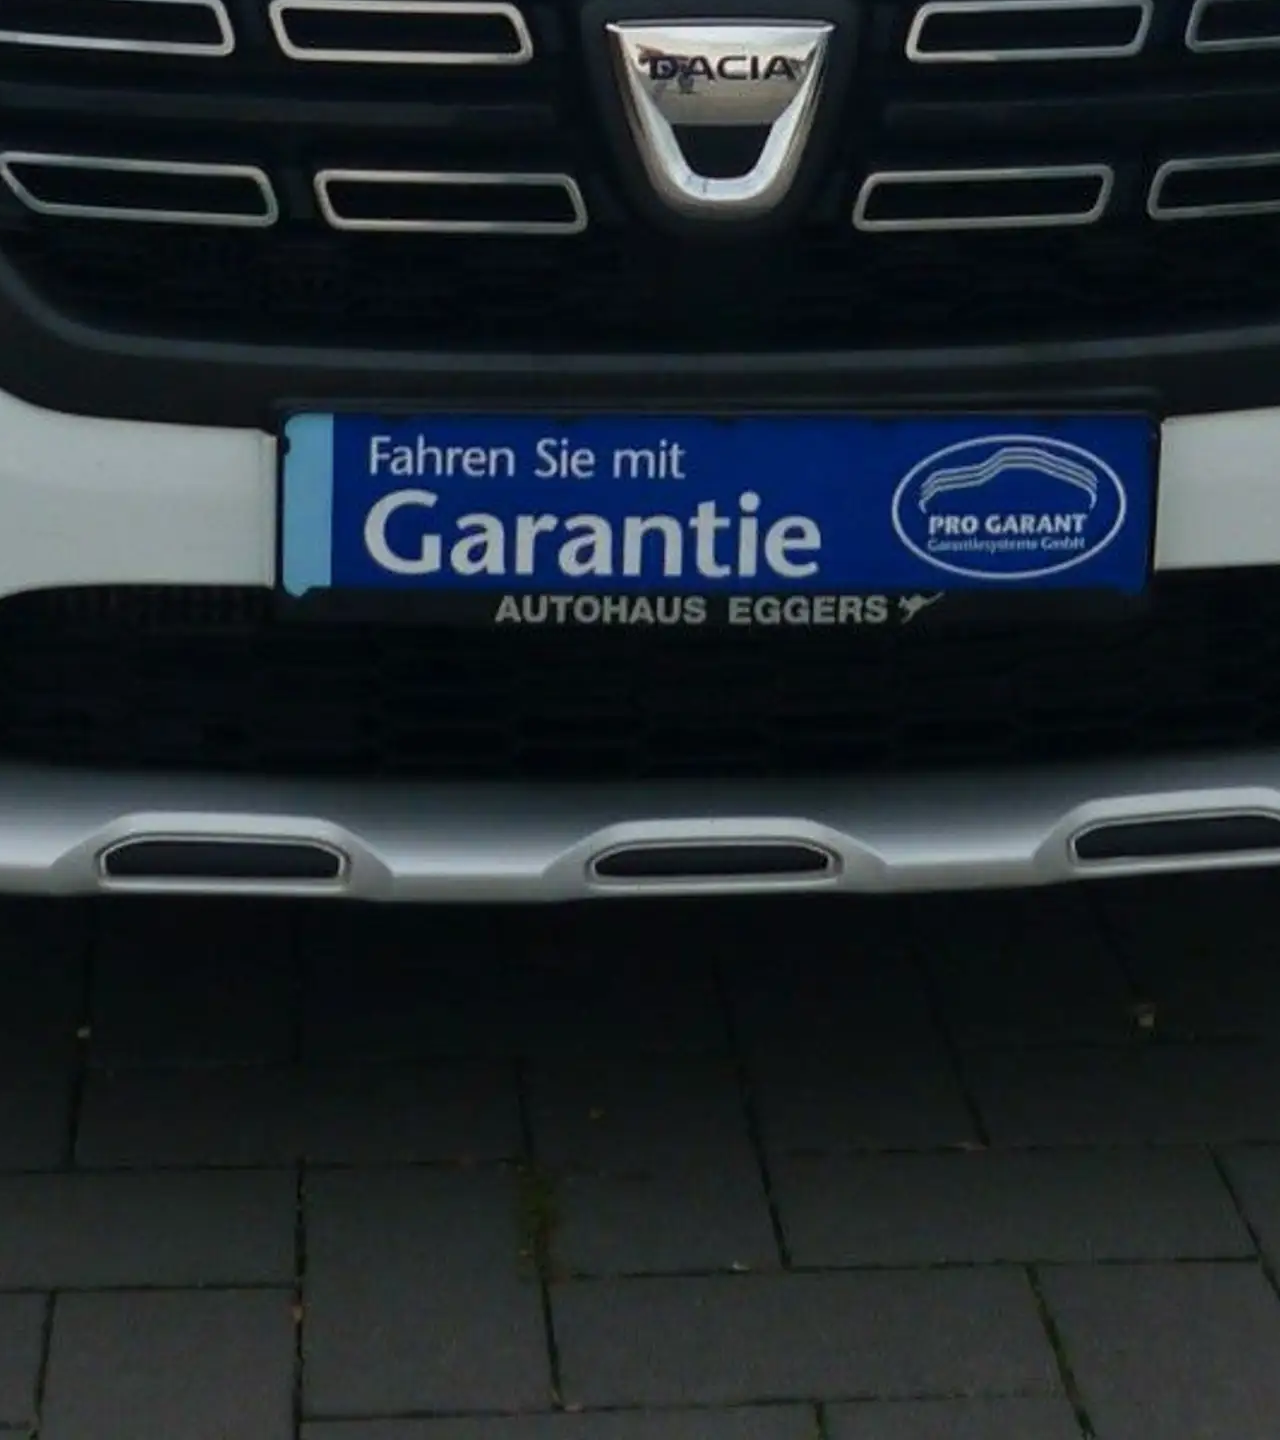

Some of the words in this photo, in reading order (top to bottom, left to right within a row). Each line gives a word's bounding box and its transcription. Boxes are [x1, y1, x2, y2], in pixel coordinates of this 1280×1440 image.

[648, 55, 796, 81] DACIA
[369, 434, 515, 478] Fahren
[533, 437, 596, 479] Sie
[612, 438, 686, 480] mit
[363, 488, 822, 578] Garantie
[928, 514, 979, 536] PRO
[984, 513, 1088, 535] GARANT
[494, 594, 708, 625] AUTOHAUS
[727, 594, 889, 625] EGGERS
